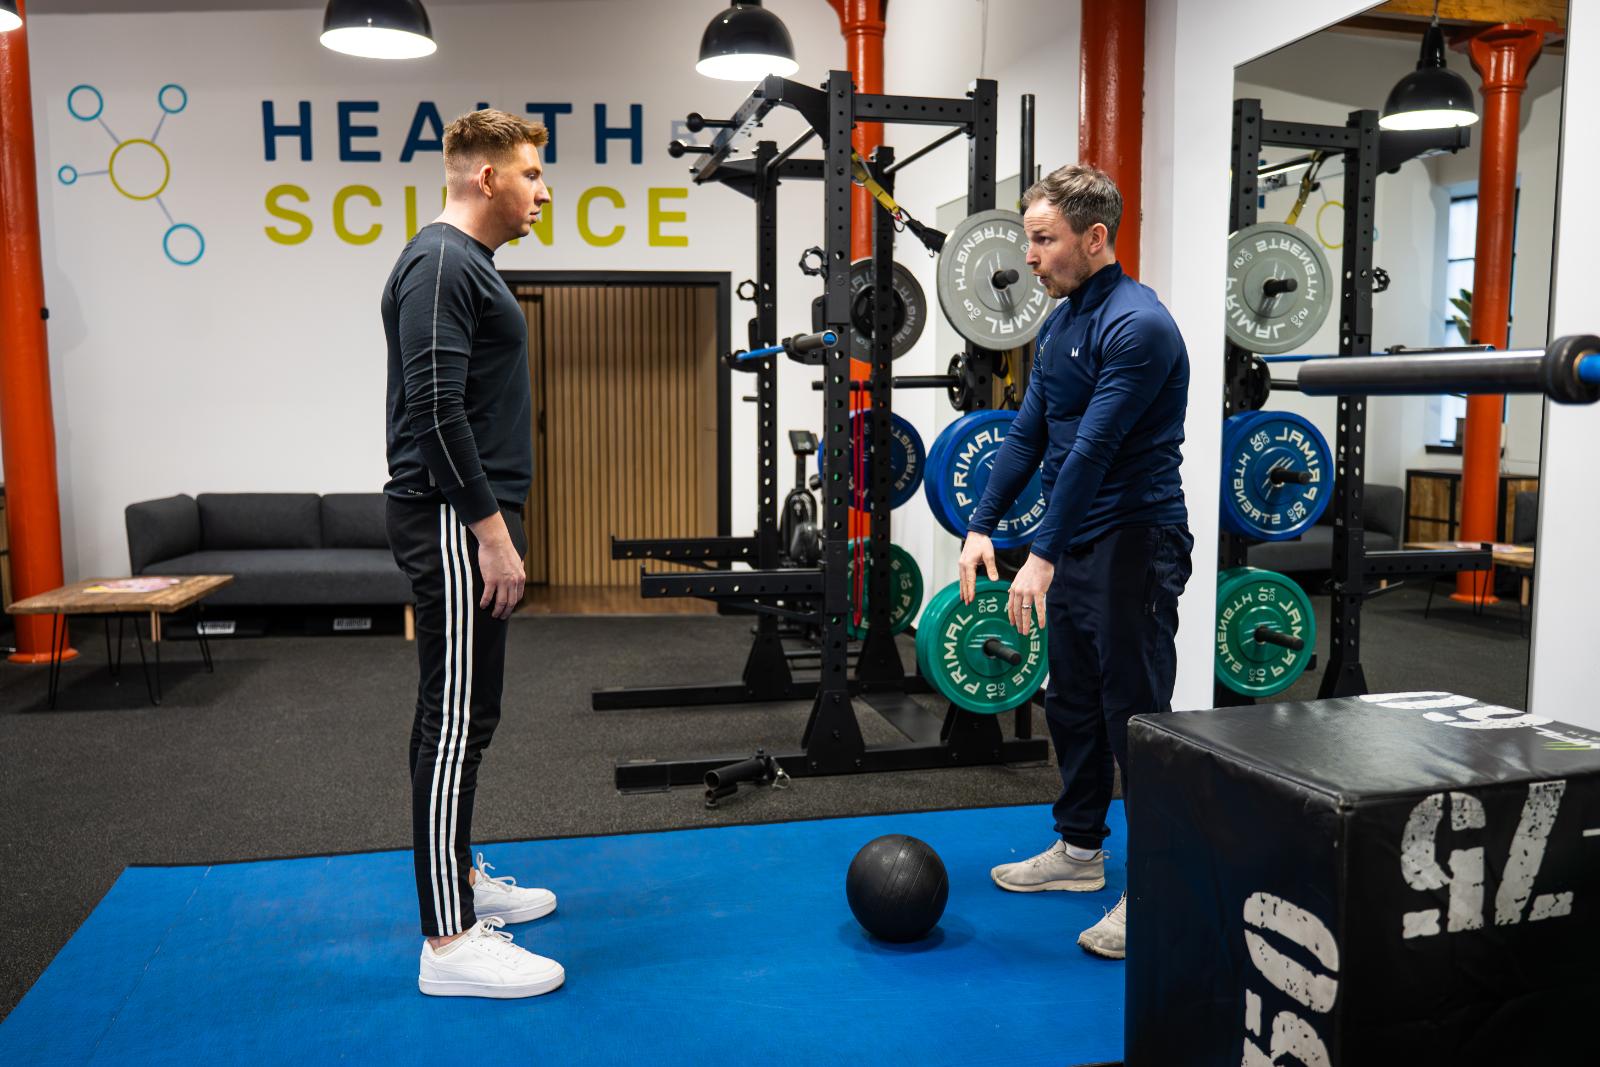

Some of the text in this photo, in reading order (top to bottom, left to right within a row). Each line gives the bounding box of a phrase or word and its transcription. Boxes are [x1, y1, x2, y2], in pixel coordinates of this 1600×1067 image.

[262, 101, 643, 164] HEATH
[955, 226, 1018, 291] STRENGTH
[963, 299, 973, 312] 5
[968, 307, 981, 320] KG
[954, 428, 1005, 507] PRIMAL
[997, 494, 1047, 531] STREN
[978, 599, 986, 613] KG
[986, 597, 998, 613] 10
[944, 614, 980, 695] PRIMAL
[1004, 603, 1040, 686] STREN
[986, 683, 997, 699] 10
[998, 682, 1006, 697] KG
[1401, 780, 1574, 939] 75
[1241, 892, 1340, 1067] 50
